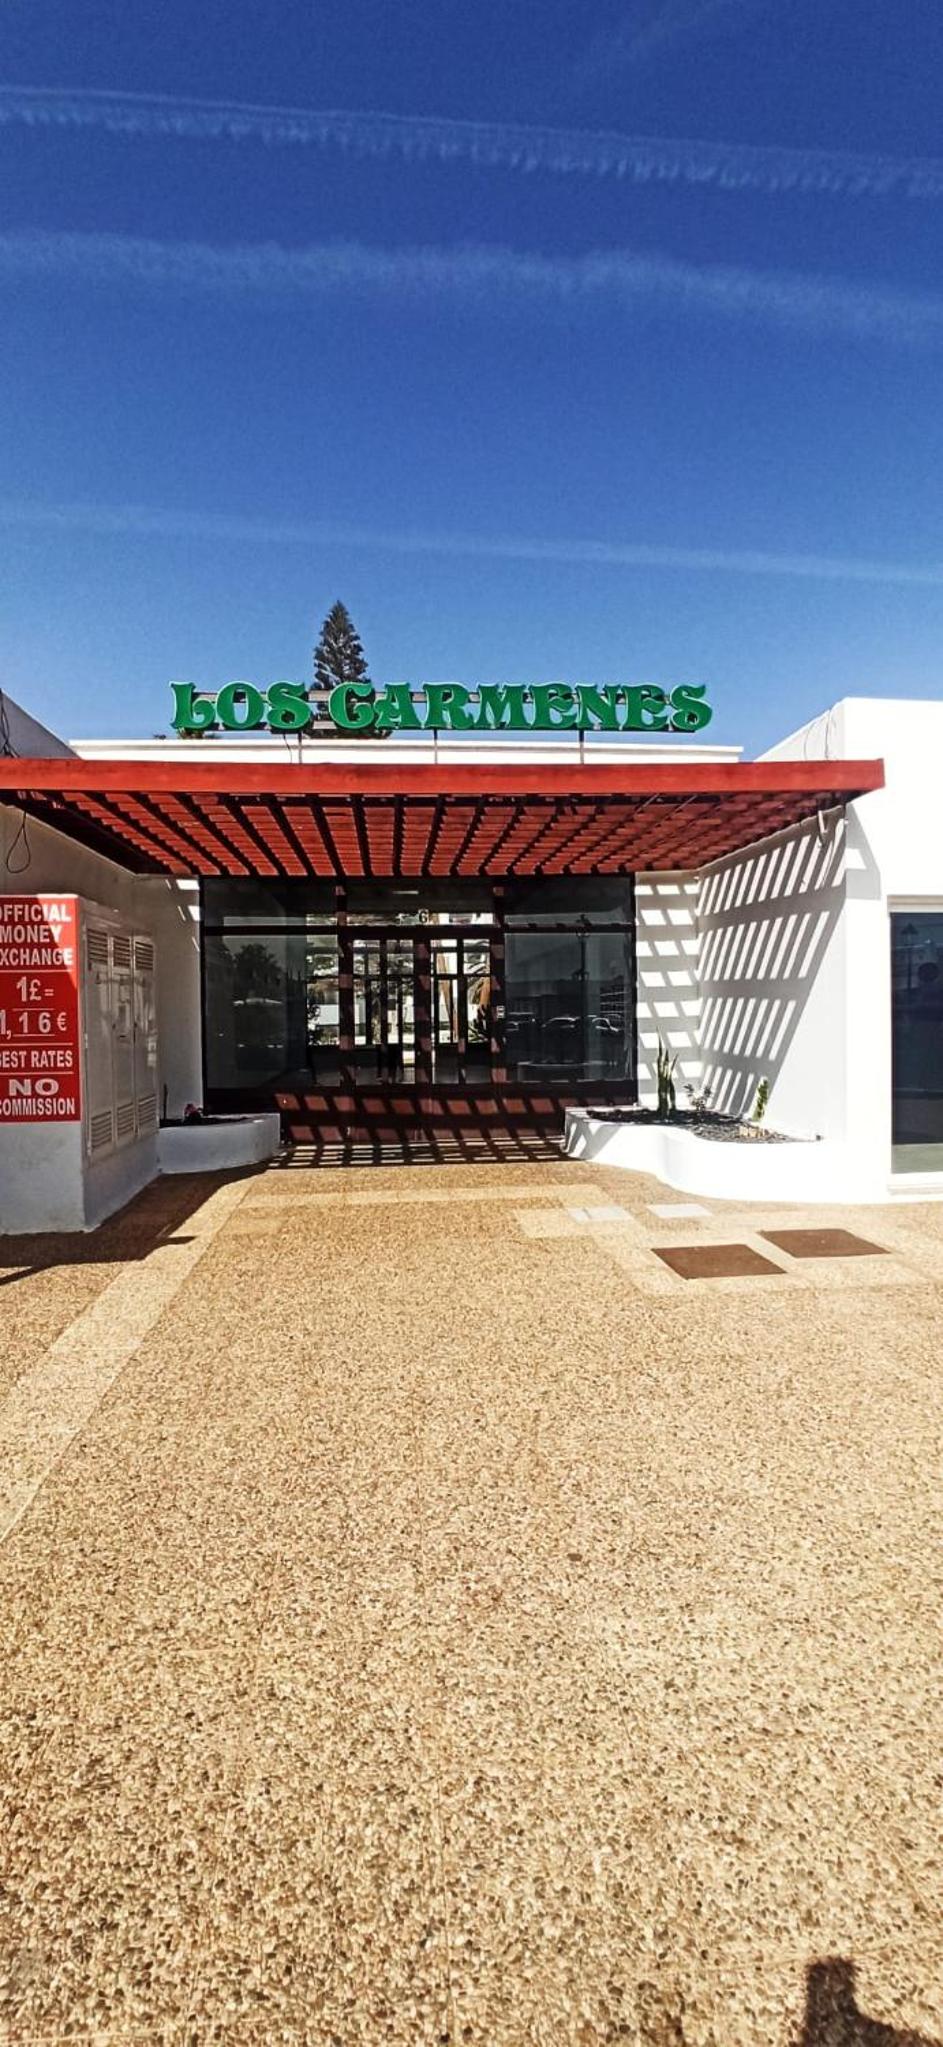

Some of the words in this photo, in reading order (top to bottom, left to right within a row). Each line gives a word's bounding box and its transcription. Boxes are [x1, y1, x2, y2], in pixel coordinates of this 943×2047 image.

[169, 682, 312, 731] LOS
[0, 906, 72, 923] FFICIAL
[418, 908, 429, 924] 6
[0, 925, 62, 943] MONEY
[0, 948, 73, 966] XCHANGE
[0, 1051, 27, 1068] EST
[30, 1050, 73, 1068] RATES
[9, 1078, 59, 1096] NO
